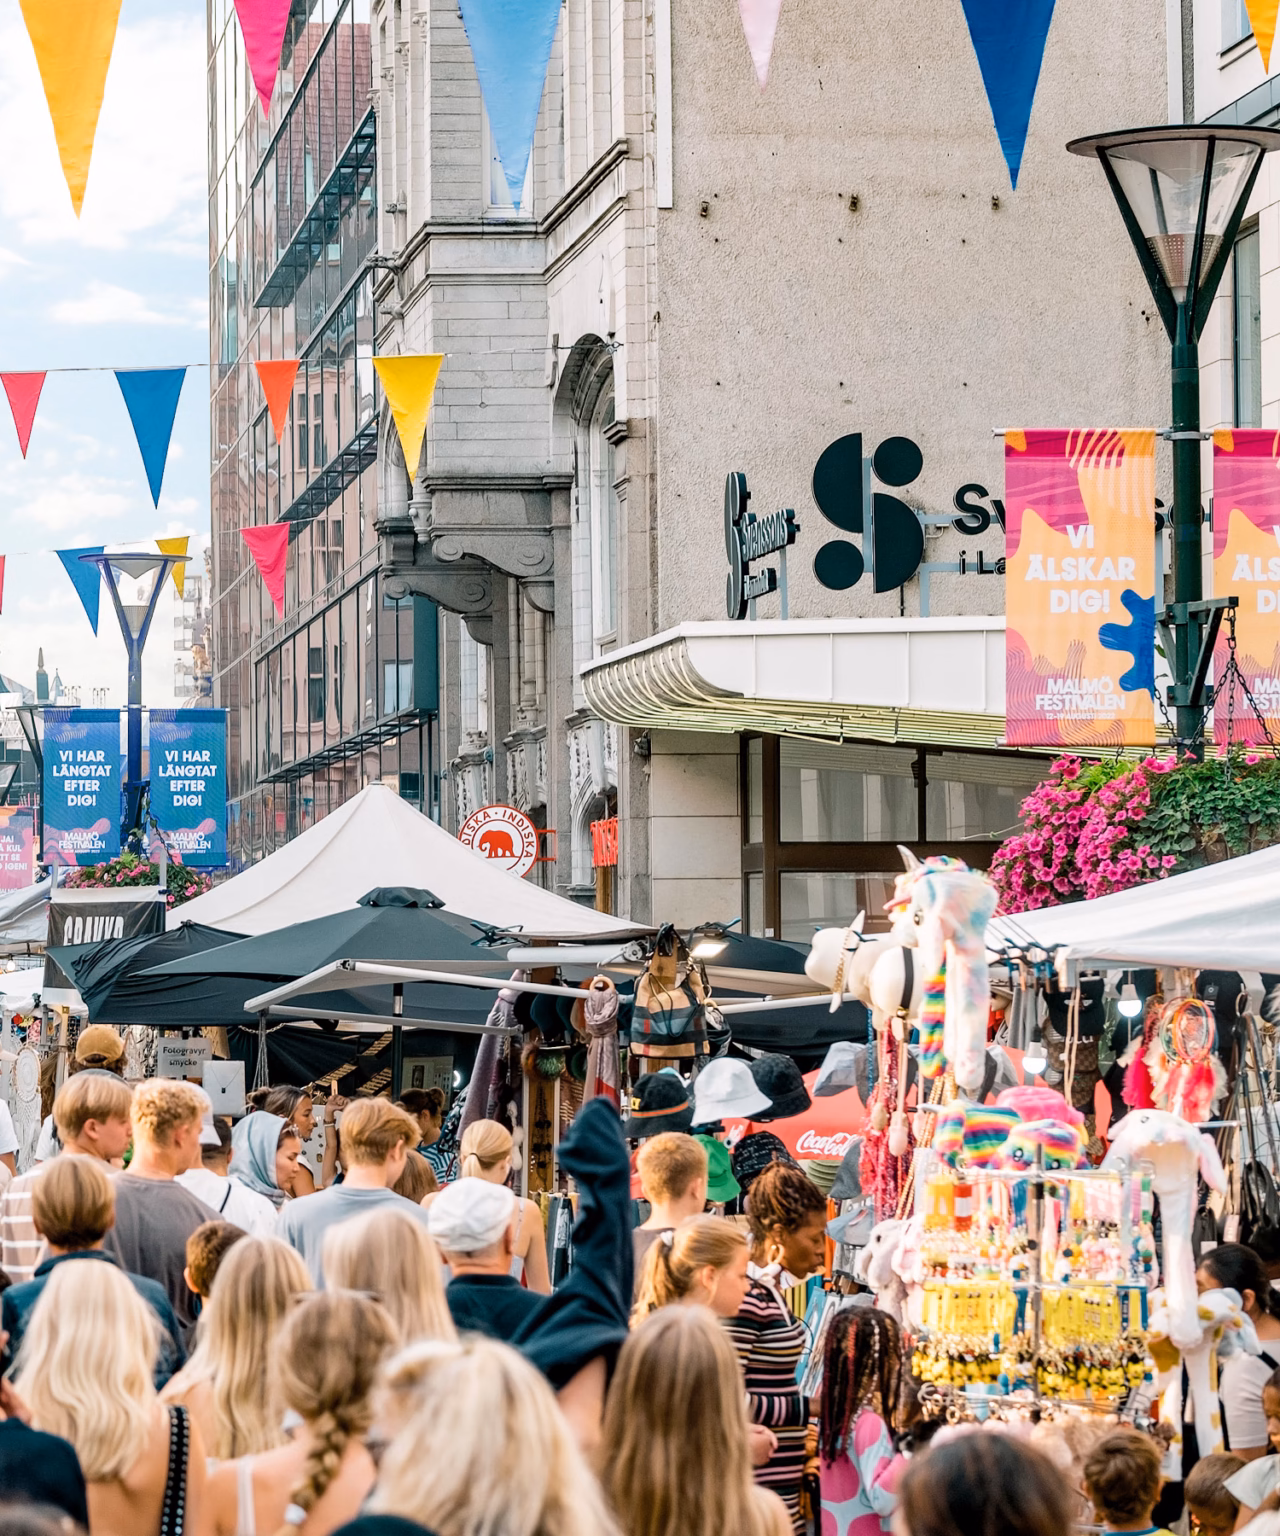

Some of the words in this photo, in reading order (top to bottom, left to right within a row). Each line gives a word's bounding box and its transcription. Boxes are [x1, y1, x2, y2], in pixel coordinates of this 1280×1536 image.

[1065, 524, 1095, 549] VI
[1024, 553, 1137, 581] ÄLSKAR
[1049, 588, 1111, 614] DIG!
[1047, 676, 1114, 694] MALMÖ
[1035, 693, 1126, 711] FESTIVALEN
[59, 750, 73, 762] VI
[76, 750, 105, 762] HAR
[164, 750, 179, 762] VI
[182, 750, 211, 762] HAR
[52, 763, 112, 777] LÄNGTAT
[158, 763, 217, 777] LÄNGTAT
[64, 780, 100, 792] EFTER
[170, 780, 206, 792] EFTER
[67, 794, 97, 807] DIG!
[173, 794, 202, 807] DIG!
[64, 831, 100, 841] MALMÖ
[502, 809, 536, 859] INDISKA
[6, 844, 22, 852] KUL
[162, 1046, 207, 1056] Fotogravyr
[169, 1058, 198, 1067] smycke
